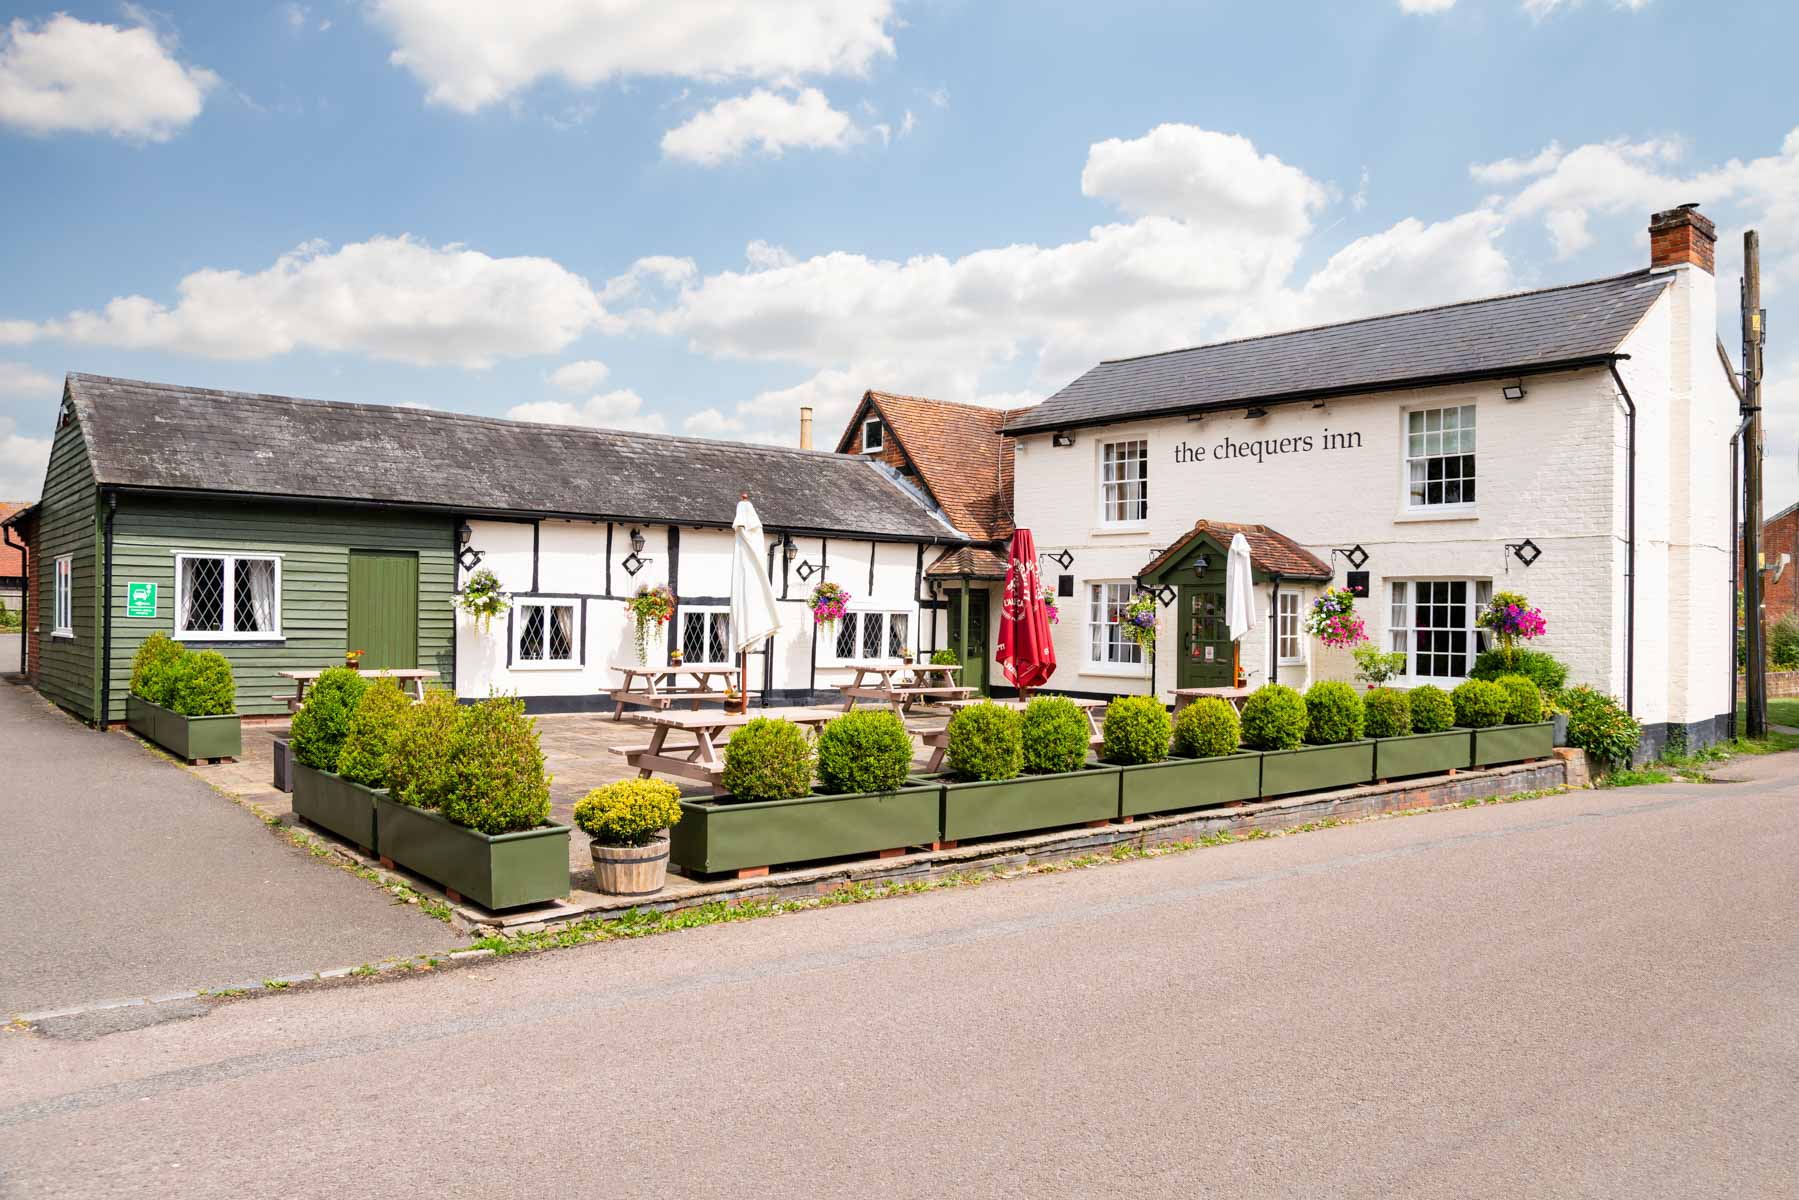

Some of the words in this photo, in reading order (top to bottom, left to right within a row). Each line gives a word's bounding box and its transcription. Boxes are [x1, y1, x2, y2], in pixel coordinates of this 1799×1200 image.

[1174, 441, 1206, 463] the
[1213, 435, 1313, 463] chequers
[1322, 428, 1362, 450] inn
